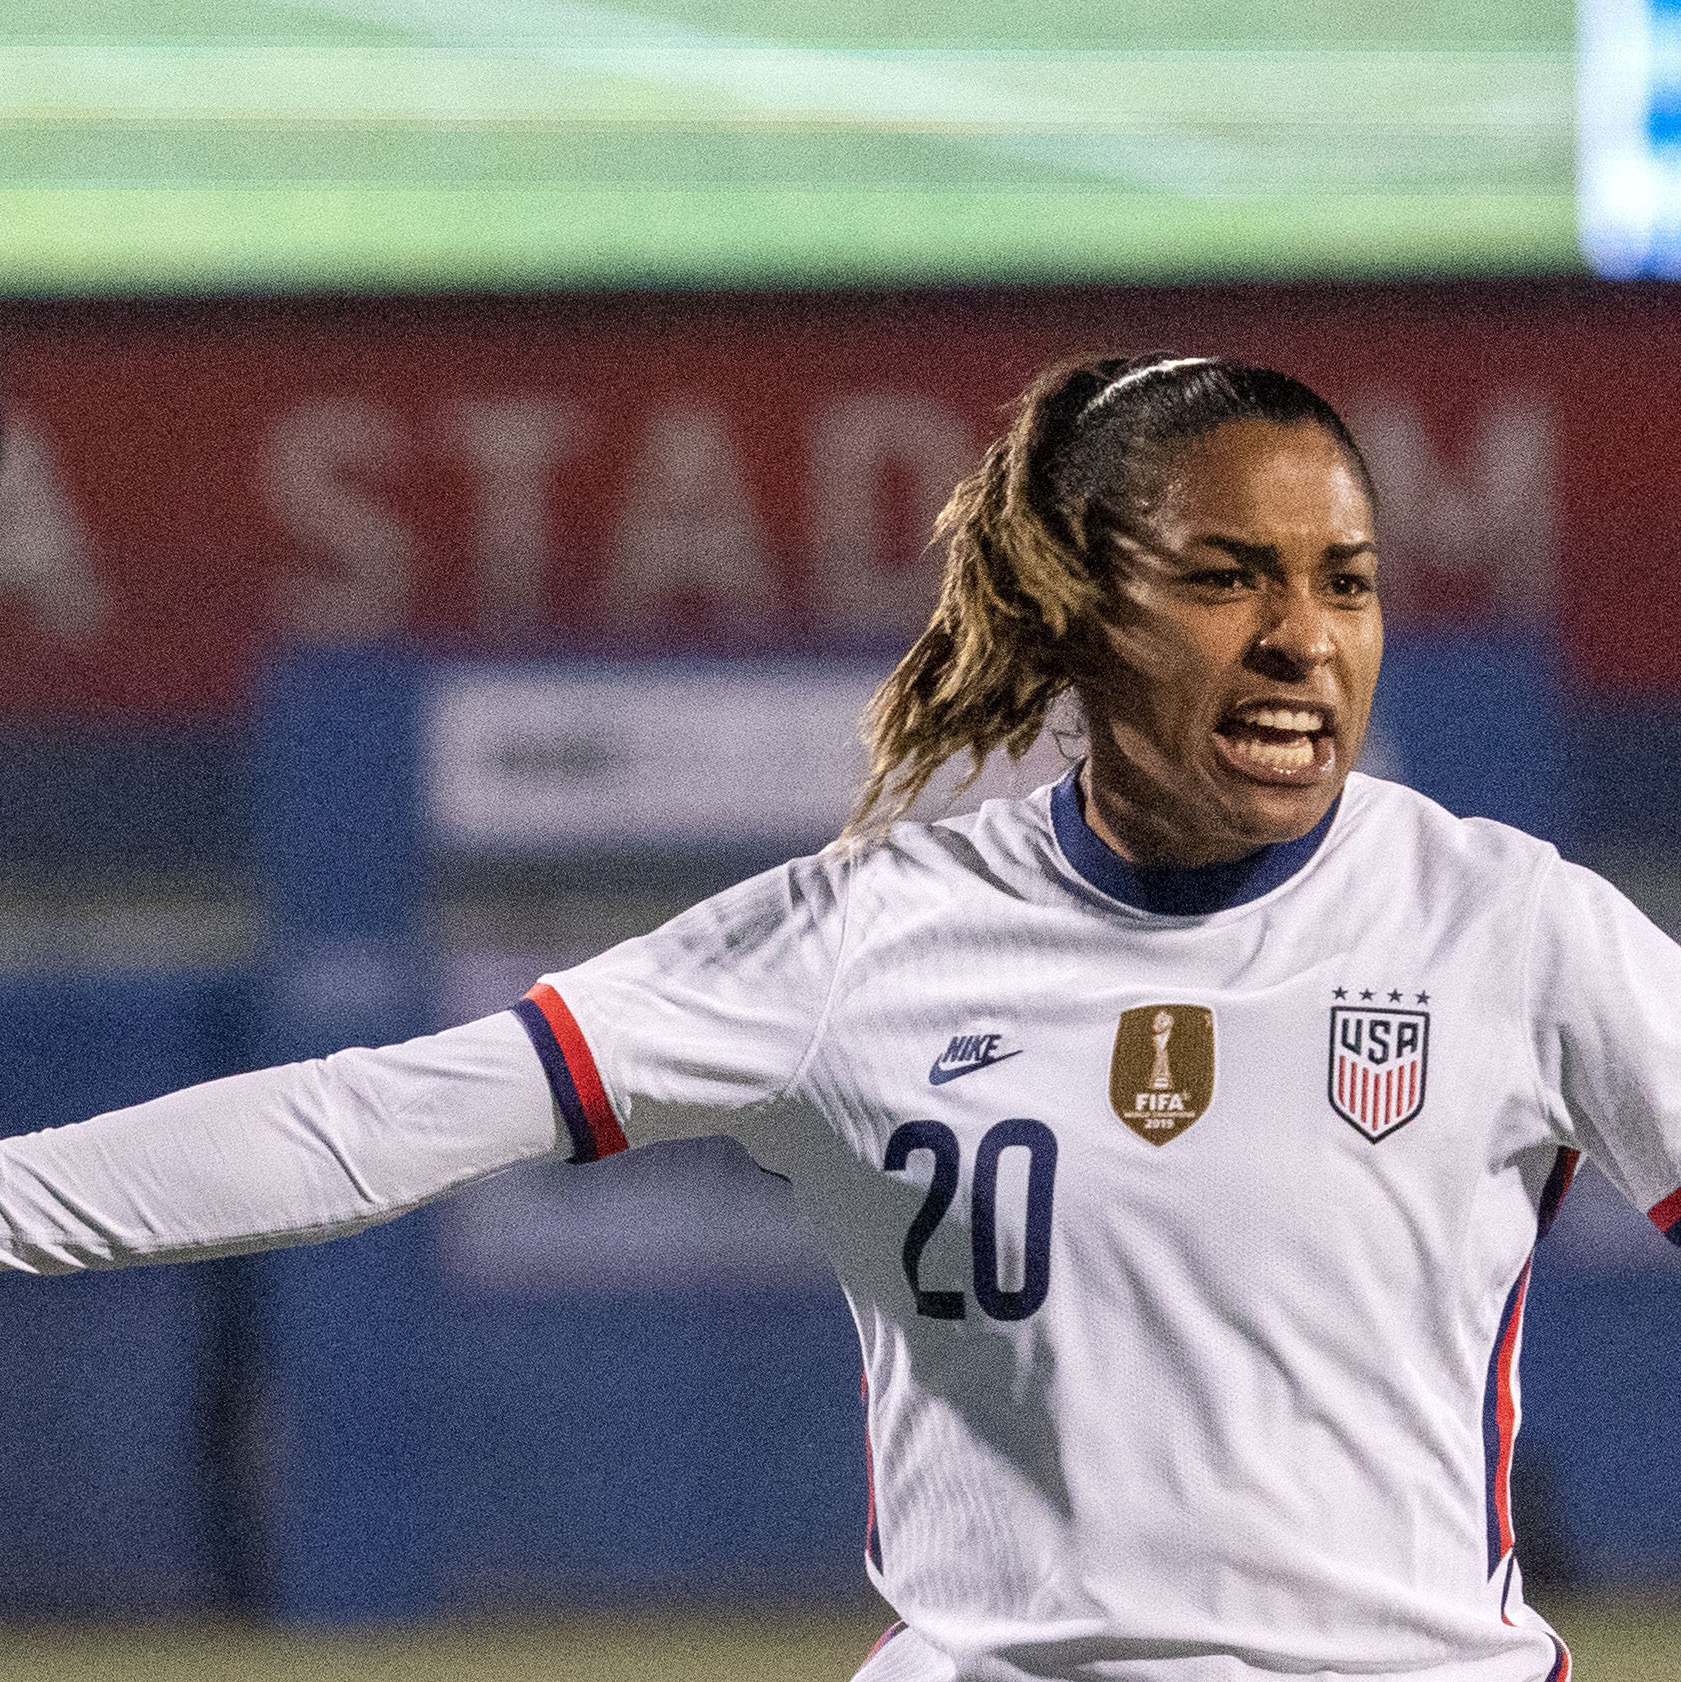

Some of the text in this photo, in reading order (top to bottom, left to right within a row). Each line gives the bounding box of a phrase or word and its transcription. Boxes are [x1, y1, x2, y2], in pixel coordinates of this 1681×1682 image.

[253, 385, 1570, 648] STADM
[940, 1033, 1002, 1064] NIKE
[1340, 1017, 1419, 1066] USA
[1135, 1092, 1185, 1112] FIFA
[882, 1116, 1059, 1322] 20
